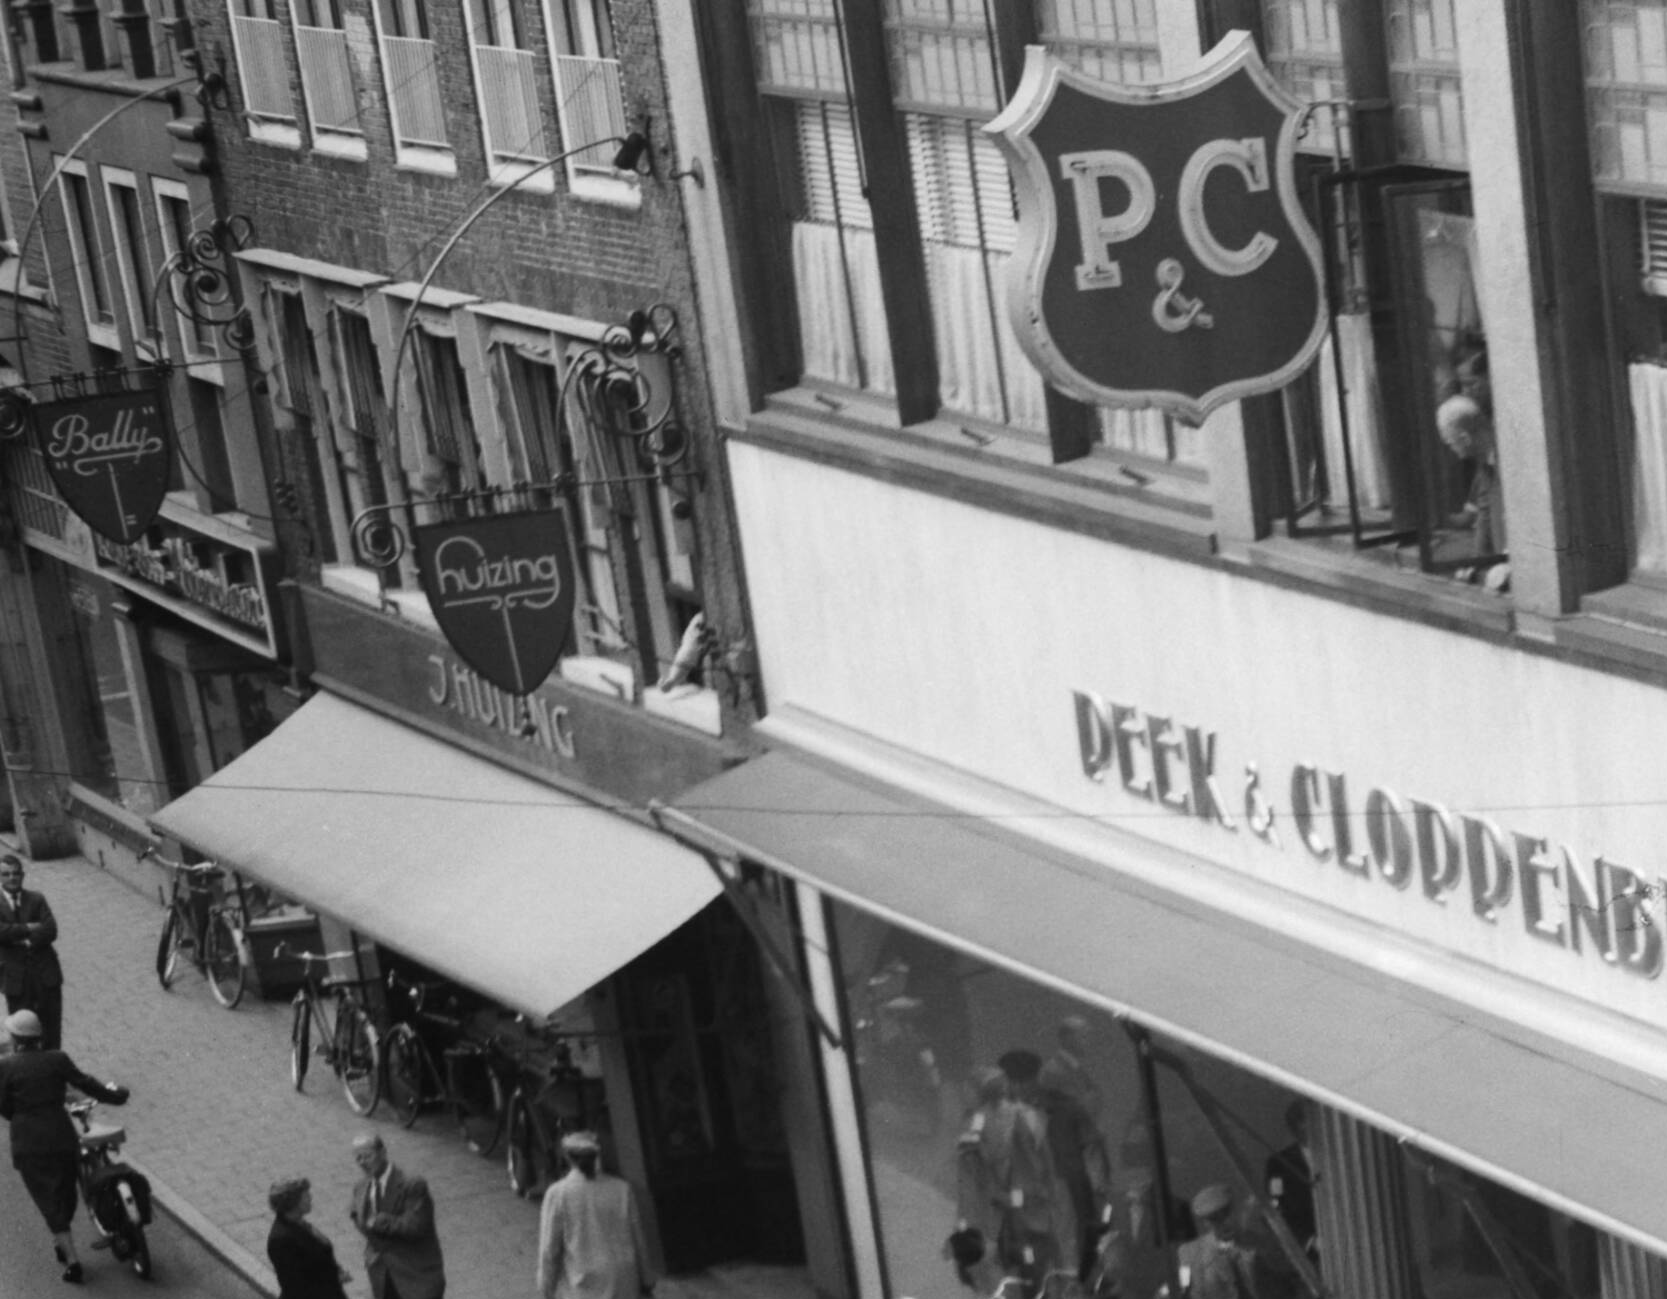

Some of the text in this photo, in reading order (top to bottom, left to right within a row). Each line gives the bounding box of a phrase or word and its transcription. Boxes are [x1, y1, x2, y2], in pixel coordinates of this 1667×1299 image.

[1058, 136, 1280, 291] P C
[1151, 257, 1215, 333] &
